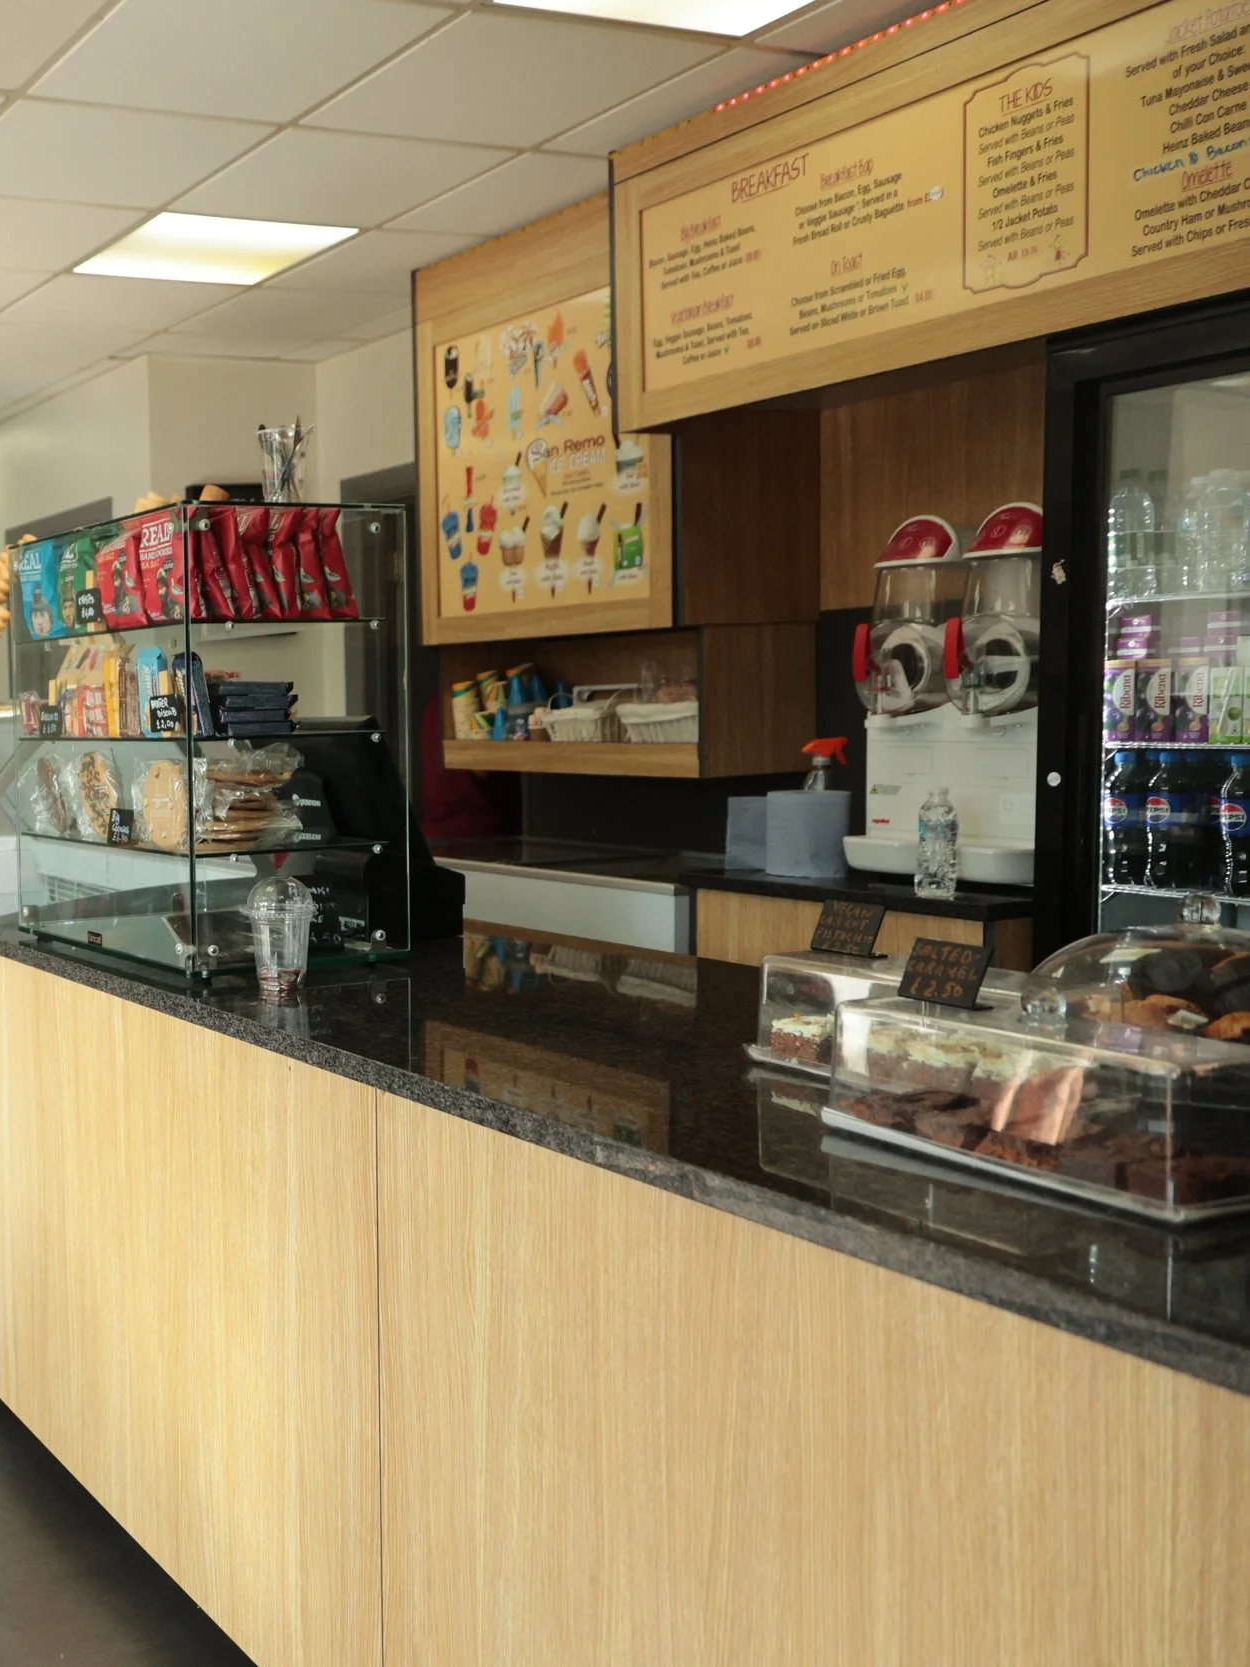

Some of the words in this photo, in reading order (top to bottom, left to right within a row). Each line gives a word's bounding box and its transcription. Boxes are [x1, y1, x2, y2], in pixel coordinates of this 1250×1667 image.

[1126, 57, 1157, 78] Served
[1160, 50, 1178, 65] with
[1181, 39, 1207, 57] Fresh
[1210, 26, 1237, 47] Salad
[1173, 65, 1182, 78] of
[1185, 59, 1207, 78] your
[999, 88, 1022, 112] THE
[1025, 77, 1053, 104] KIDS
[1140, 93, 1163, 108] Tuna
[1217, 69, 1224, 81] &
[1169, 95, 1210, 116] Cheddar
[1212, 81, 1249, 101] Cheese
[978, 120, 1009, 138] Chicken
[1011, 108, 1043, 126] Nuggets
[1045, 104, 1051, 114] &
[1053, 97, 1074, 111] Fries
[978, 137, 1003, 155] Served
[1005, 132, 1019, 145] with
[1021, 124, 1044, 140] Beans
[1046, 121, 1054, 131] or
[1055, 114, 1075, 127] Peas
[1170, 116, 1193, 134] Chilli
[1196, 112, 1215, 125] Con
[1217, 101, 1247, 118] Carne
[987, 155, 1003, 168] Fish
[1005, 145, 1034, 161] Fingers
[1036, 140, 1041, 151] &
[1043, 135, 1064, 149] Fries
[1162, 139, 1189, 154] Heinz
[1191, 128, 1221, 146] Baked
[731, 153, 810, 203] BREAKFAST
[978, 171, 1003, 188] Served
[1005, 165, 1019, 178] with
[1020, 158, 1044, 173] Beans
[1045, 155, 1053, 165] or
[1055, 147, 1075, 161] Peas
[1133, 158, 1185, 182] Chicken
[1206, 139, 1247, 160] Bacon
[795, 202, 817, 216] Choose
[819, 196, 833, 208] from
[873, 173, 902, 189] Sausage
[978, 203, 1003, 220] Served
[1004, 199, 1019, 211] with
[1020, 191, 1044, 207] Beans
[1045, 188, 1053, 198] or
[1055, 182, 1074, 195] Peas
[992, 179, 1028, 199] Omelette
[1030, 176, 1035, 186] &
[1037, 171, 1058, 184] Fries
[1134, 201, 1175, 221] Omelette
[1178, 194, 1197, 209] with
[1199, 183, 1241, 202] Cheddar
[793, 233, 810, 246] Fresh
[811, 227, 829, 240] Bread
[830, 221, 842, 233] Roll
[844, 220, 850, 229] or
[852, 213, 873, 227] Crusty
[874, 202, 905, 219] Baguette
[907, 197, 923, 208] from
[799, 222, 805, 230] or
[807, 214, 827, 227] Veggie
[828, 204, 855, 220] Sausage
[862, 194, 885, 208] Served
[886, 191, 893, 200] in
[992, 218, 1003, 231] 1/2
[1005, 211, 1031, 228] Jacket
[1032, 204, 1058, 219] Potato
[1143, 218, 1179, 236] Country
[1181, 212, 1202, 225] Ham
[1204, 209, 1215, 220] or
[978, 236, 1003, 252] Served
[1004, 231, 1018, 244] with
[1020, 224, 1043, 240] Beans
[1045, 222, 1053, 233] or
[1055, 216, 1074, 229] Peas
[1132, 241, 1163, 257] Served
[1165, 235, 1184, 248] with
[1186, 227, 1213, 243] Chips
[1216, 224, 1226, 235] or
[791, 295, 813, 307] Choose
[815, 289, 828, 300] from
[830, 277, 864, 296] Scrambled
[865, 276, 872, 285] or
[873, 270, 890, 283] Fried
[821, 297, 856, 313] Mushrooms
[858, 294, 864, 303] or
[866, 284, 897, 300] Tomatoes
[789, 321, 810, 336] Served
[812, 320, 819, 330] on
[820, 314, 839, 327] Sliced
[841, 310, 858, 323] White
[860, 308, 866, 317] or
[868, 302, 889, 315] Brown
[891, 295, 909, 308] Toast
[564, 434, 605, 454] Remo
[139, 522, 174, 548] REAL
[1119, 674, 1132, 709] Ribena
[1154, 673, 1167, 709] Ribena
[1193, 672, 1206, 708] Ribena
[907, 960, 978, 981] CARAMEL
[912, 944, 972, 964] SALTED
